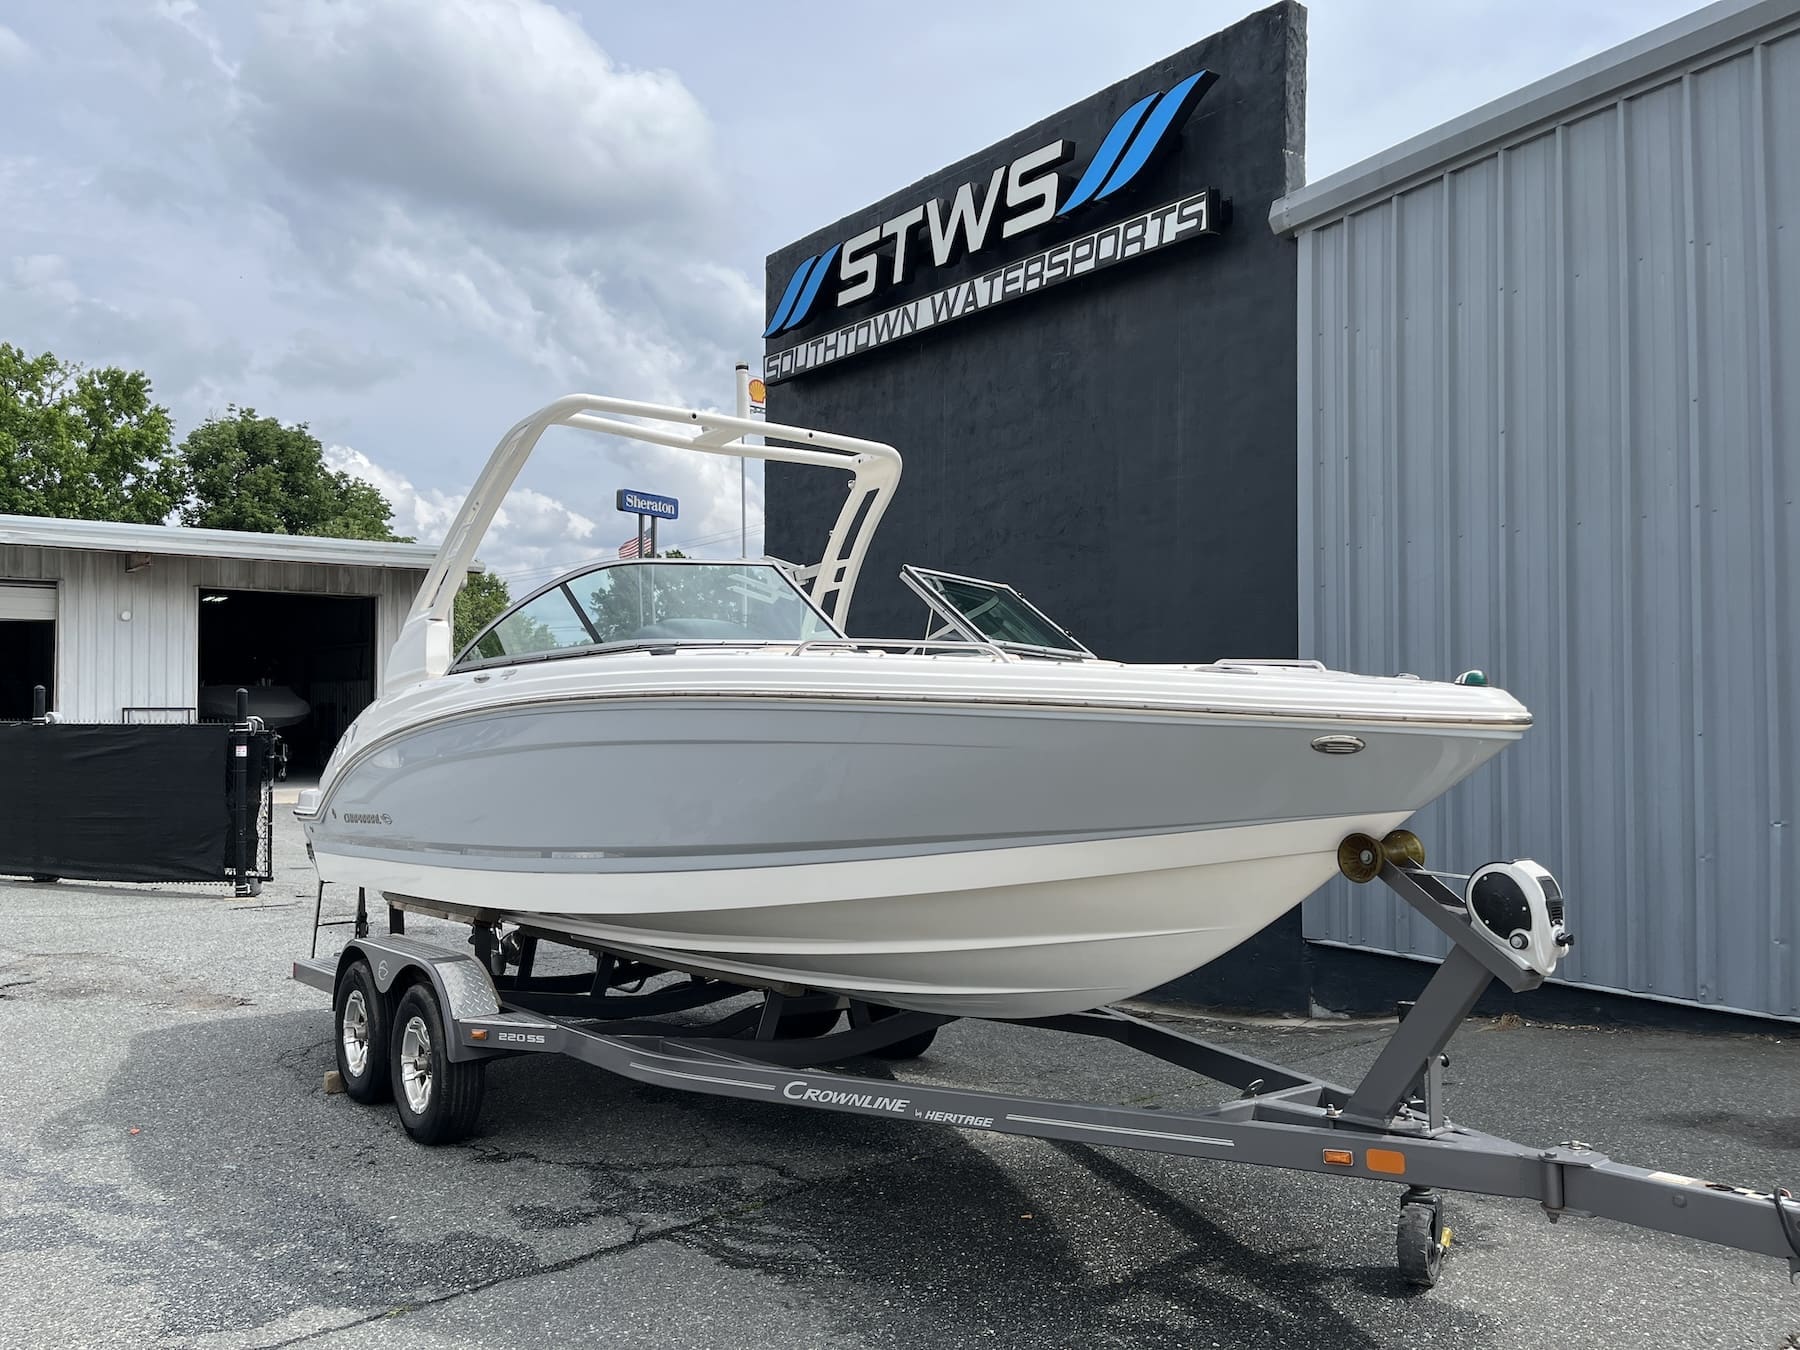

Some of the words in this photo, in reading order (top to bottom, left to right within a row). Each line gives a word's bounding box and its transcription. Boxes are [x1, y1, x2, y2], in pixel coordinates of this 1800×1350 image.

[837, 138, 1064, 307] STWS
[765, 300, 919, 379] SOUTHTOWN
[930, 196, 1206, 323] WATERSPORTS
[625, 494, 675, 515] Sheraton
[924, 1110, 995, 1128] HERITAGE
